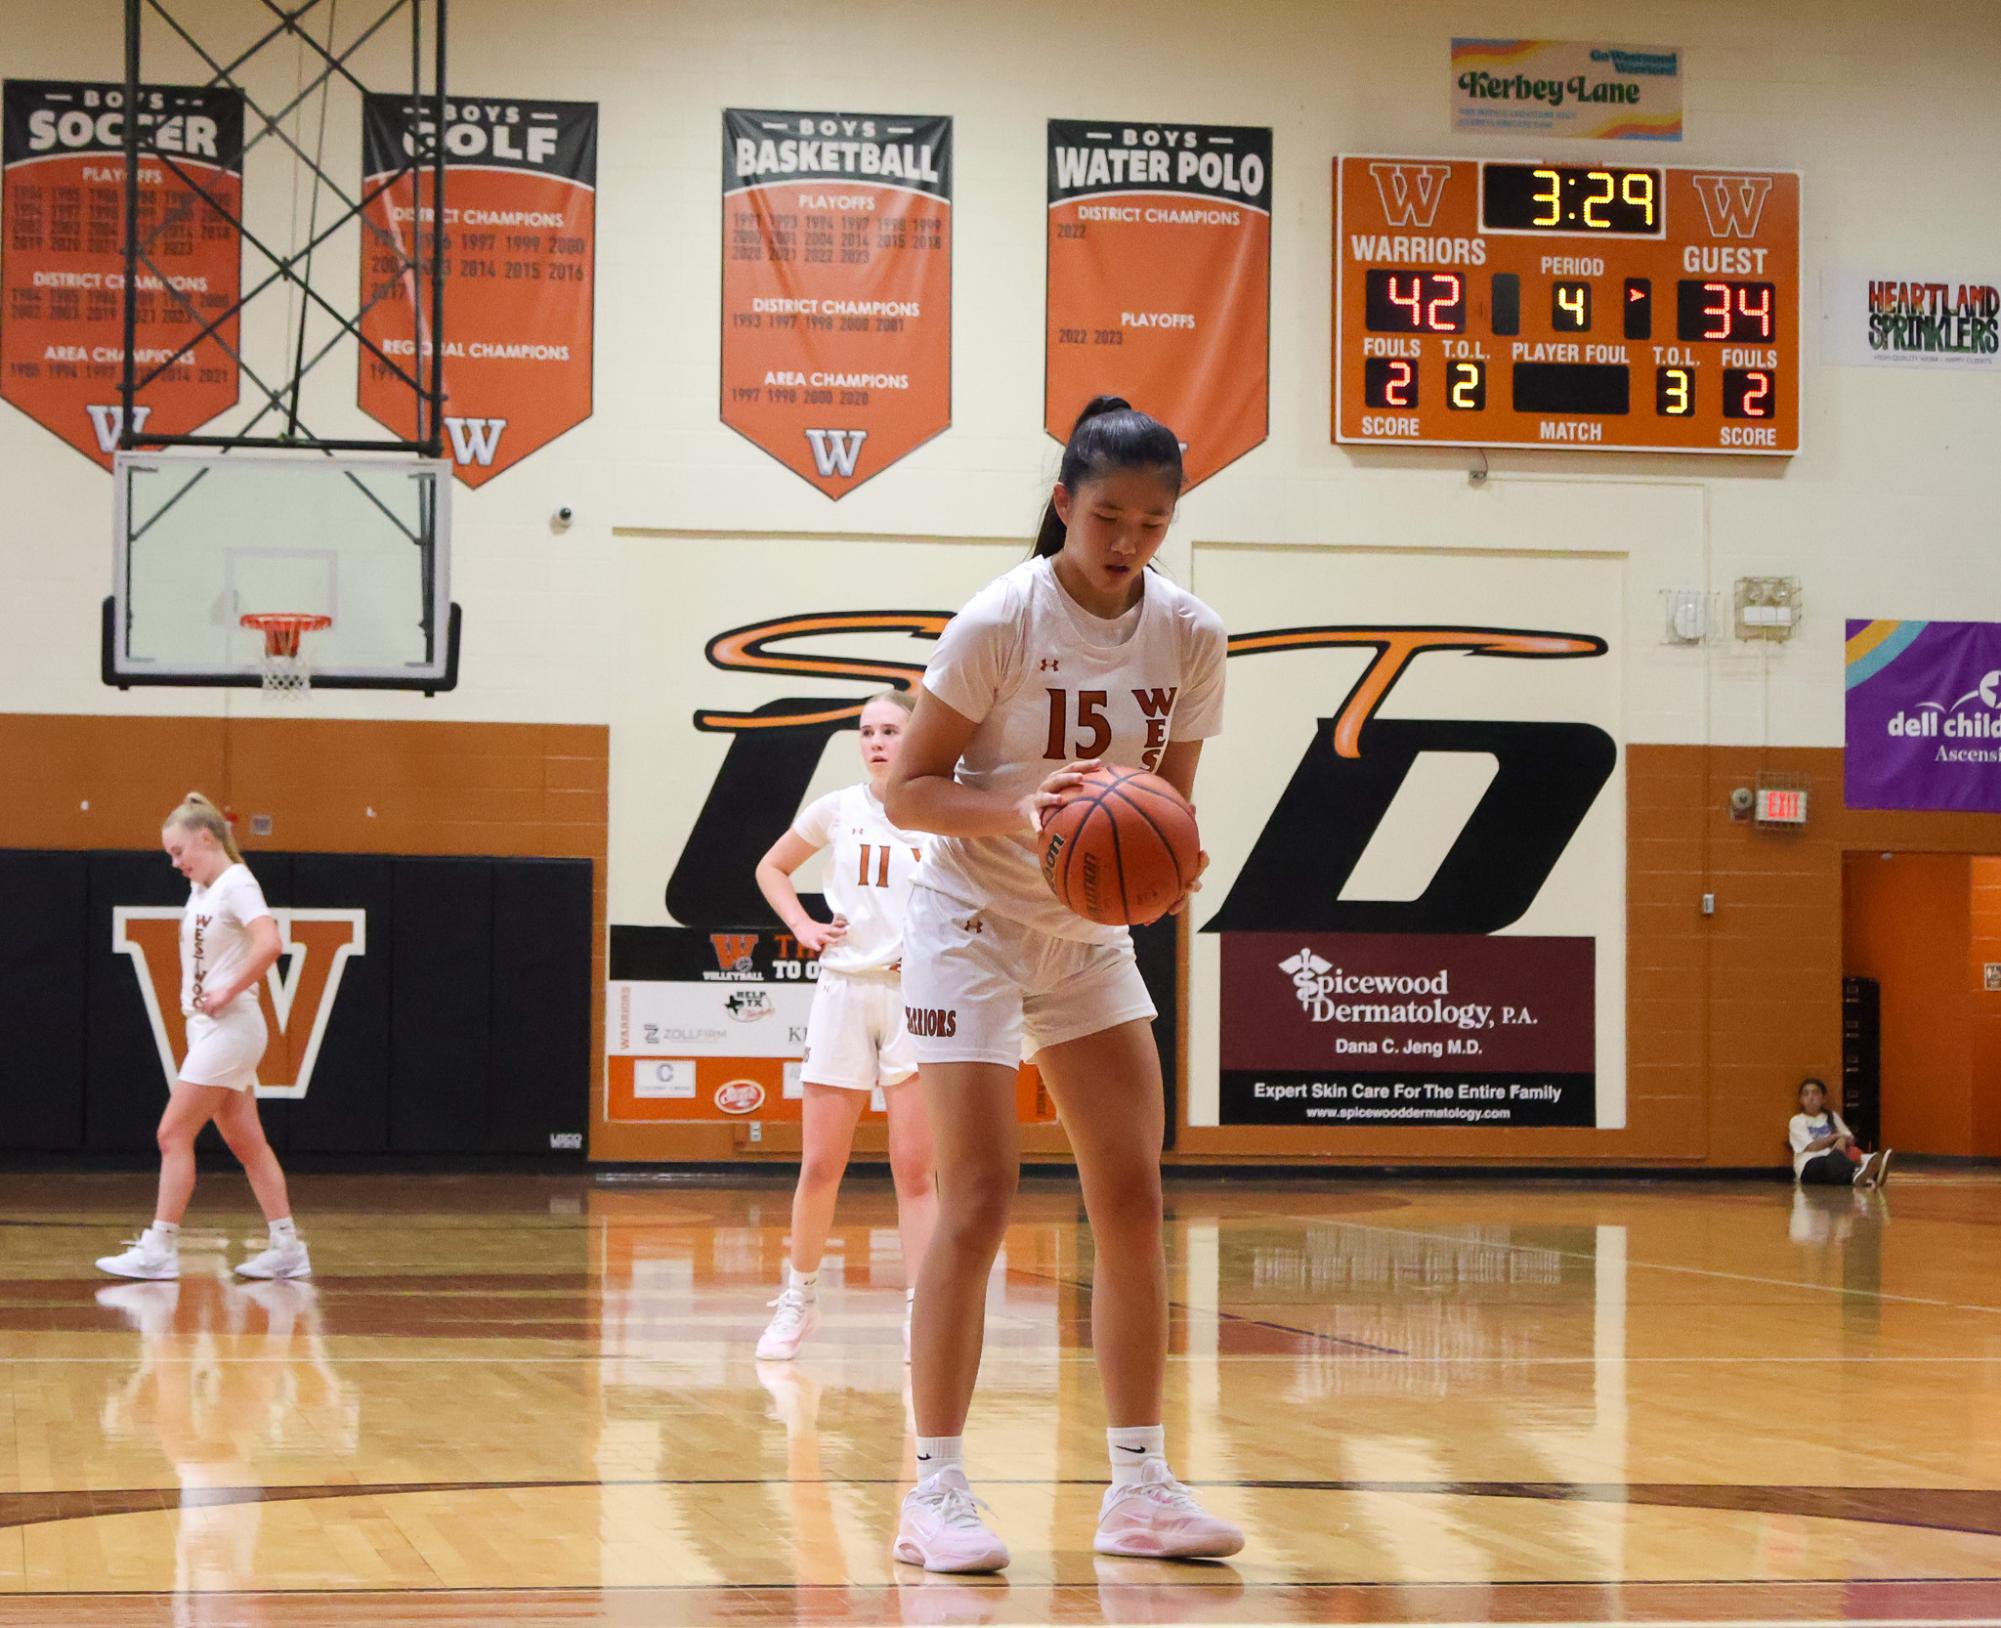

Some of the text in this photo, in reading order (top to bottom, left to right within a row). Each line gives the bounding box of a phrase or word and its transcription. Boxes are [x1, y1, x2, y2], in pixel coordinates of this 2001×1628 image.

[1458, 71, 1641, 106] Kerbey Lane
[444, 104, 520, 124] BOYS
[800, 118, 876, 138] BOYS
[1123, 129, 1198, 148] BOYS
[736, 138, 938, 183] BASKETBALL
[1056, 147, 1265, 196] WATER POLO
[799, 194, 875, 210] PLAYOFFS
[1369, 163, 1451, 227] W
[1532, 170, 1653, 228] 3:29
[1692, 175, 1773, 238] W
[464, 210, 564, 228] CHAMPIONS
[1078, 206, 1240, 226] DISTRICT CHAMPIONS
[1351, 235, 1486, 265] WARRIORS
[1683, 246, 1768, 275] GUEST
[1541, 256, 1604, 276] PERIOD
[753, 298, 920, 317] DISTRICT CHAMPIONS
[1388, 274, 1460, 331] 42
[1558, 288, 1584, 326] 4
[1868, 280, 2000, 317] HEARTLAND
[1121, 312, 1195, 329] PLAYOFFS
[1703, 283, 1769, 339] 34
[1868, 313, 2000, 354] SPRINKLERS
[44, 345, 88, 361] AREA
[469, 343, 570, 361] CHAMPIONS
[1363, 338, 1421, 357] FOULS
[1442, 340, 1491, 359] T.O.L.
[1512, 343, 1630, 364] PLAYER FOUL
[1653, 347, 1700, 366] T.O.L.
[1721, 349, 1778, 368] FOULS
[764, 371, 909, 389] AREA CHAMPIONS
[1385, 361, 1411, 406] 2
[1453, 363, 1479, 408] 2
[1665, 369, 1688, 414] 3
[1743, 372, 1768, 417] 2
[1362, 415, 1420, 436] SCORE
[1540, 421, 1602, 441] MATCH
[1720, 426, 1777, 446] SCORE
[444, 417, 507, 466] W
[805, 429, 868, 477] W
[1042, 687, 1112, 760] 15
[1887, 711, 1938, 737] dell
[1767, 791, 1799, 818] EXIT
[857, 843, 891, 888] 11
[772, 960, 801, 979] TO
[736, 991, 767, 999] HELP
[1293, 968, 1449, 1001] Spicewood
[1311, 998, 1538, 1029] Dermatology, P.A.
[1336, 1039, 1483, 1057] Dana C. Jeng M.D.
[1254, 1083, 1562, 1102] Expert Skin Care For The Entire Family
[1306, 1106, 1511, 1121] www.spicewooddermatology.com
